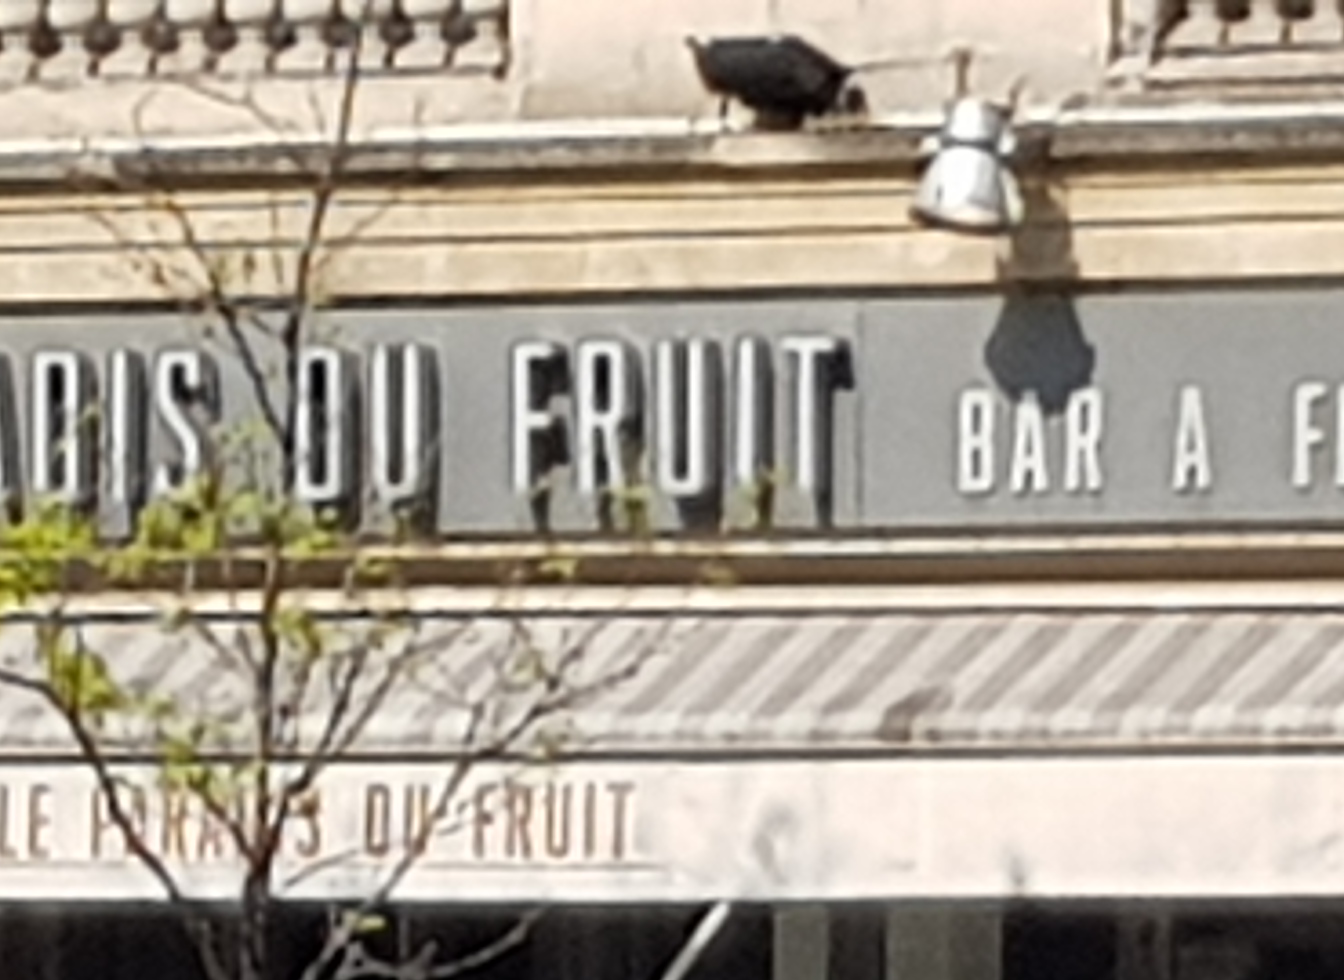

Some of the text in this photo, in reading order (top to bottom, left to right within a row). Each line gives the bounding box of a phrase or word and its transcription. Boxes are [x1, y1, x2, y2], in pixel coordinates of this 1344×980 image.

[295, 342, 418, 501] DU
[511, 334, 836, 497] FRUIT
[957, 387, 1104, 494] BAR
[1171, 385, 1213, 492] A
[474, 779, 636, 859] FRUIT
